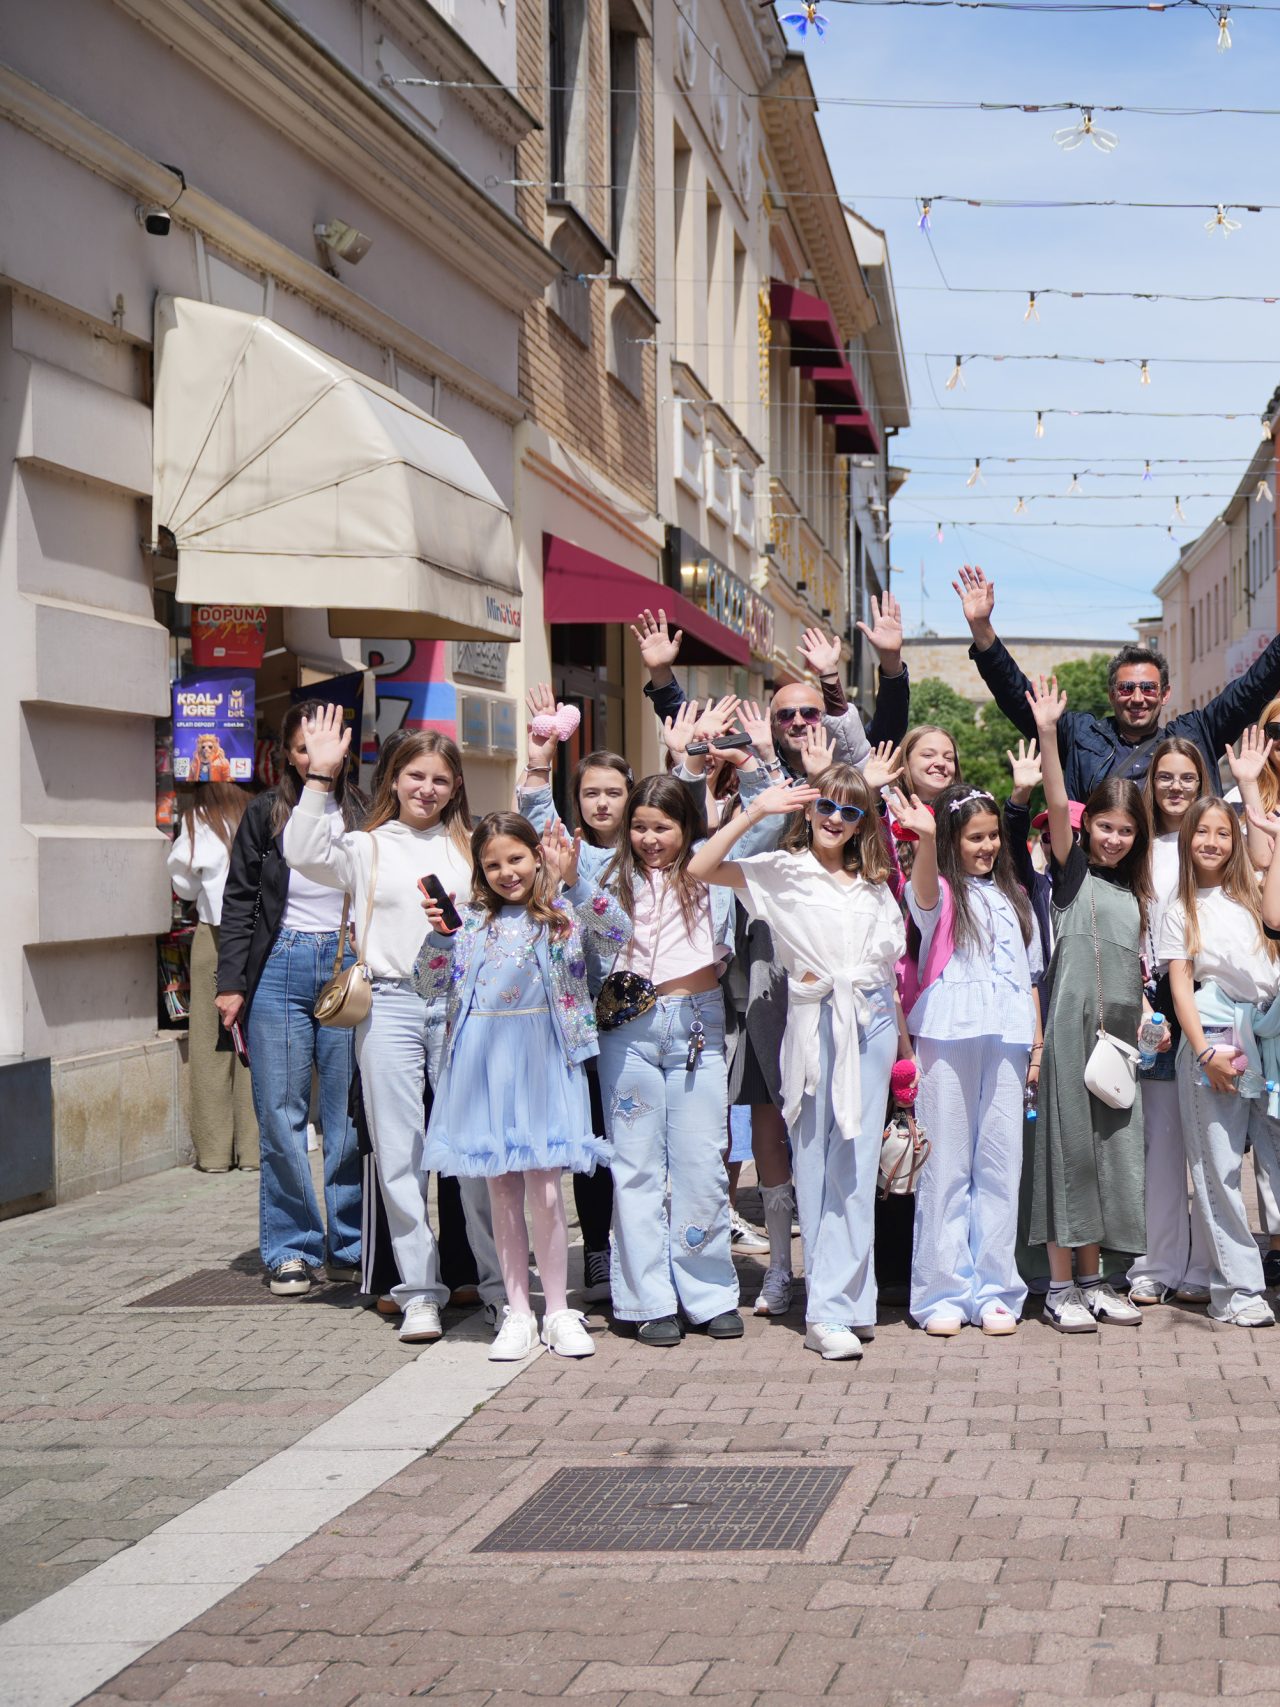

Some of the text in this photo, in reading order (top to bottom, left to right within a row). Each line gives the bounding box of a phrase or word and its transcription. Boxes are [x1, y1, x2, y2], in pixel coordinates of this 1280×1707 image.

[199, 607, 267, 623] DOPUNA
[177, 693, 223, 705] KRALJ
[182, 705, 216, 717] IGRE
